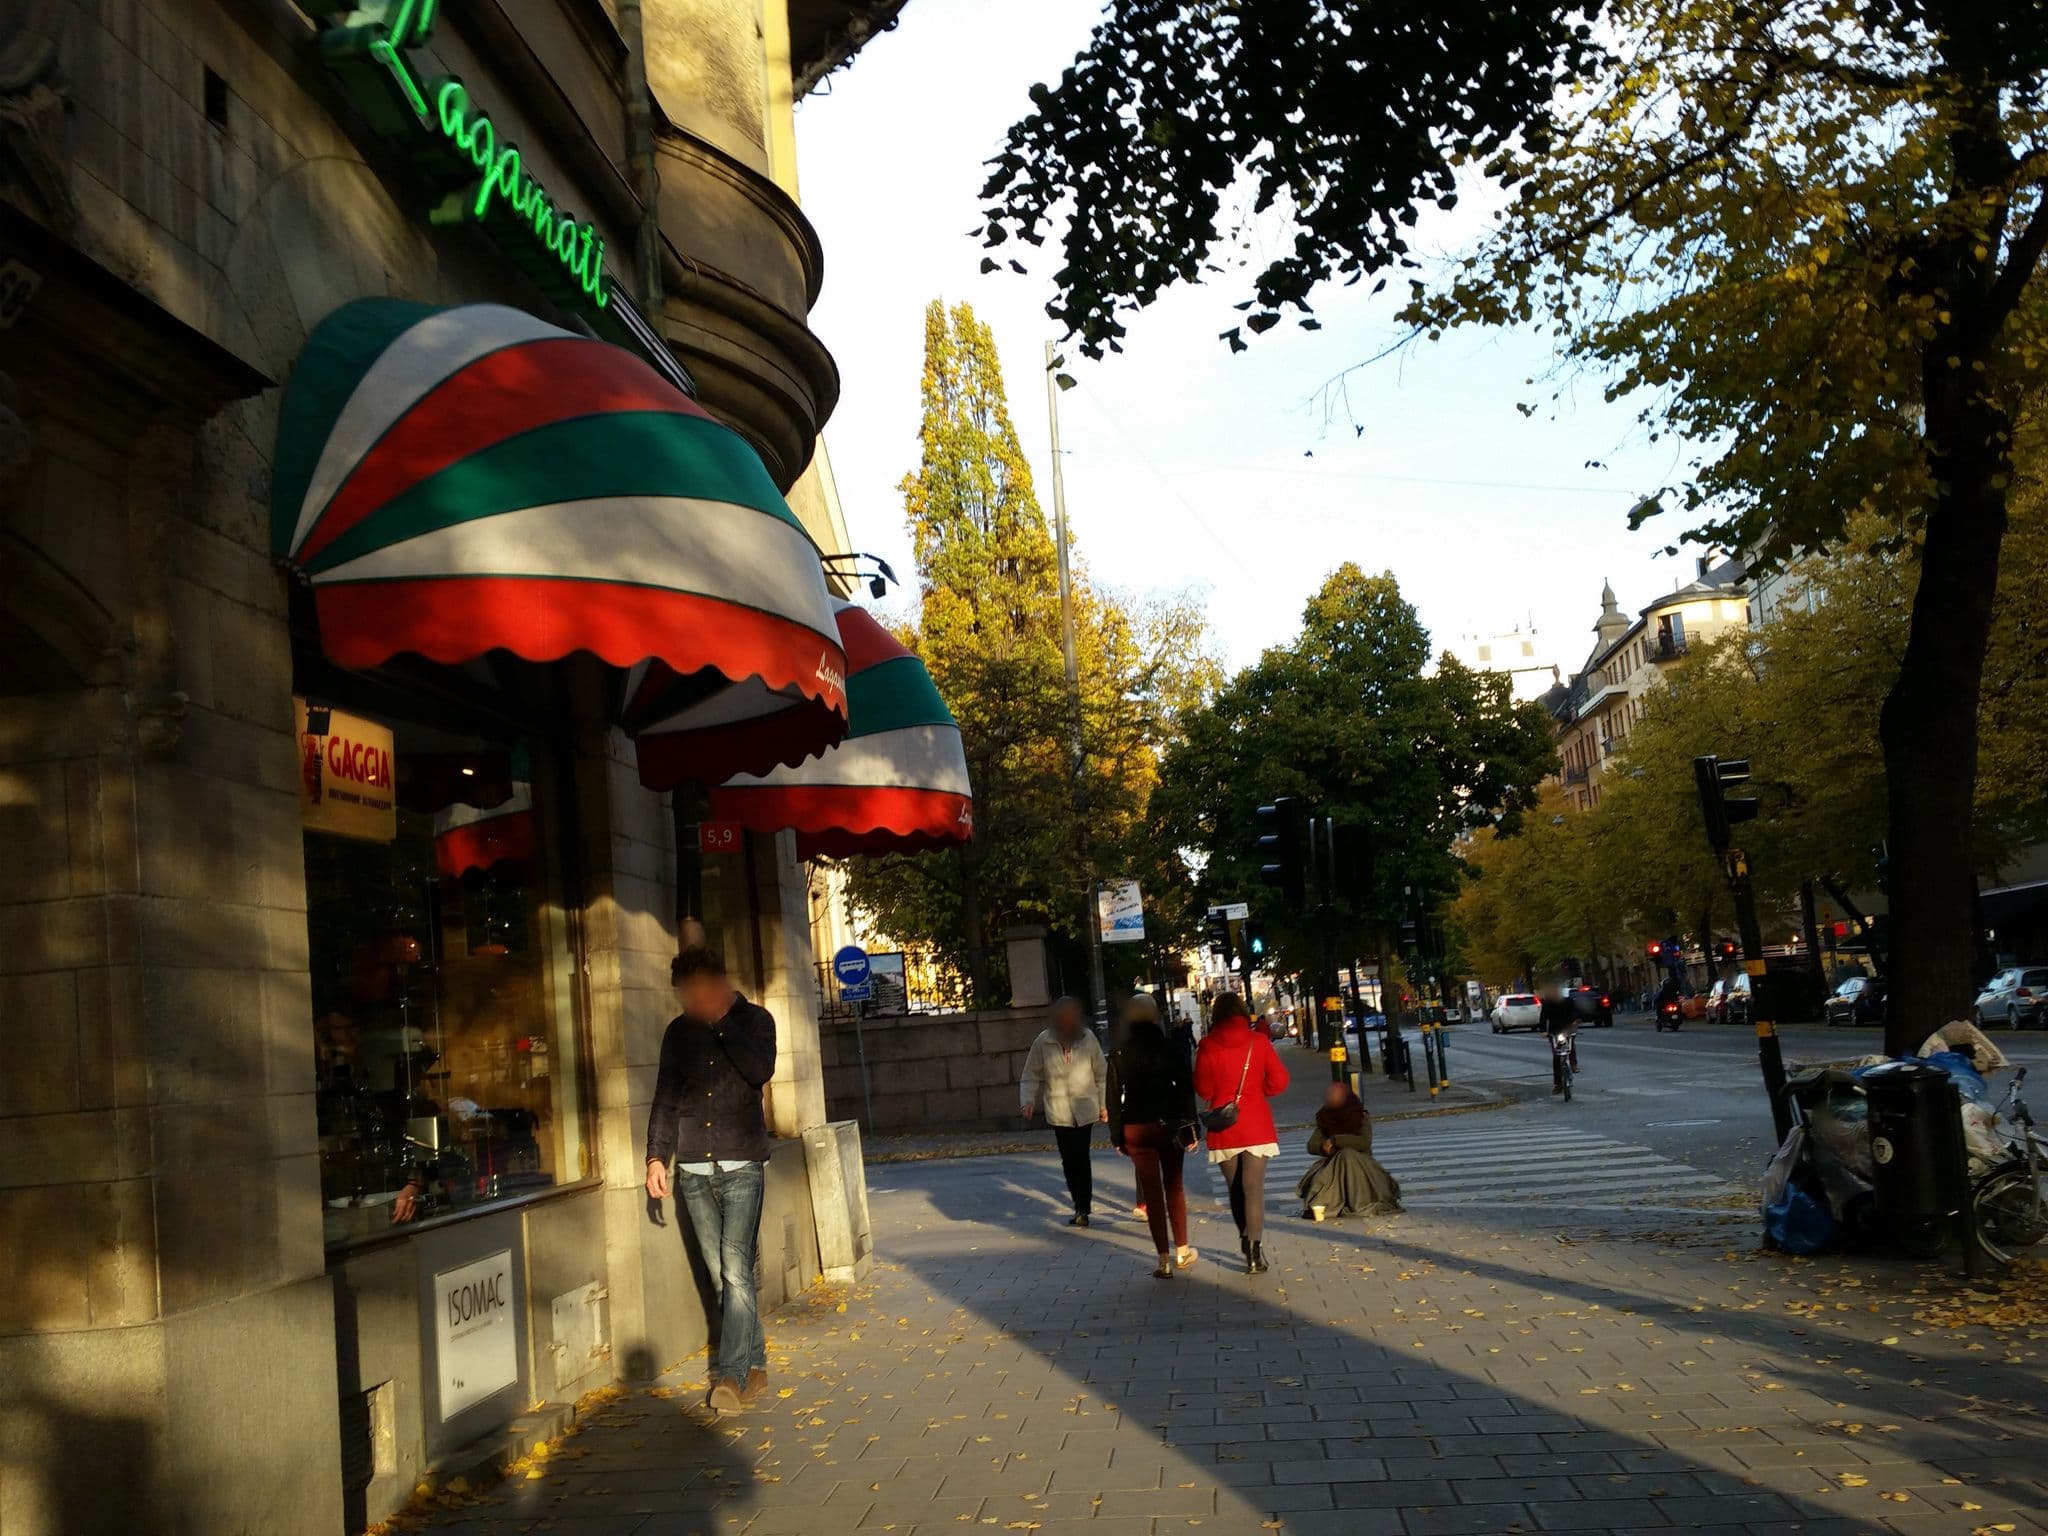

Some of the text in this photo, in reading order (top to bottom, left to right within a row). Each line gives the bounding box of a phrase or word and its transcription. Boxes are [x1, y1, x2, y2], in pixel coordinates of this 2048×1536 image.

[328, 735, 392, 790] GAGGIA
[708, 828, 732, 847] 5,9
[448, 1273, 505, 1328] ISOMAC
